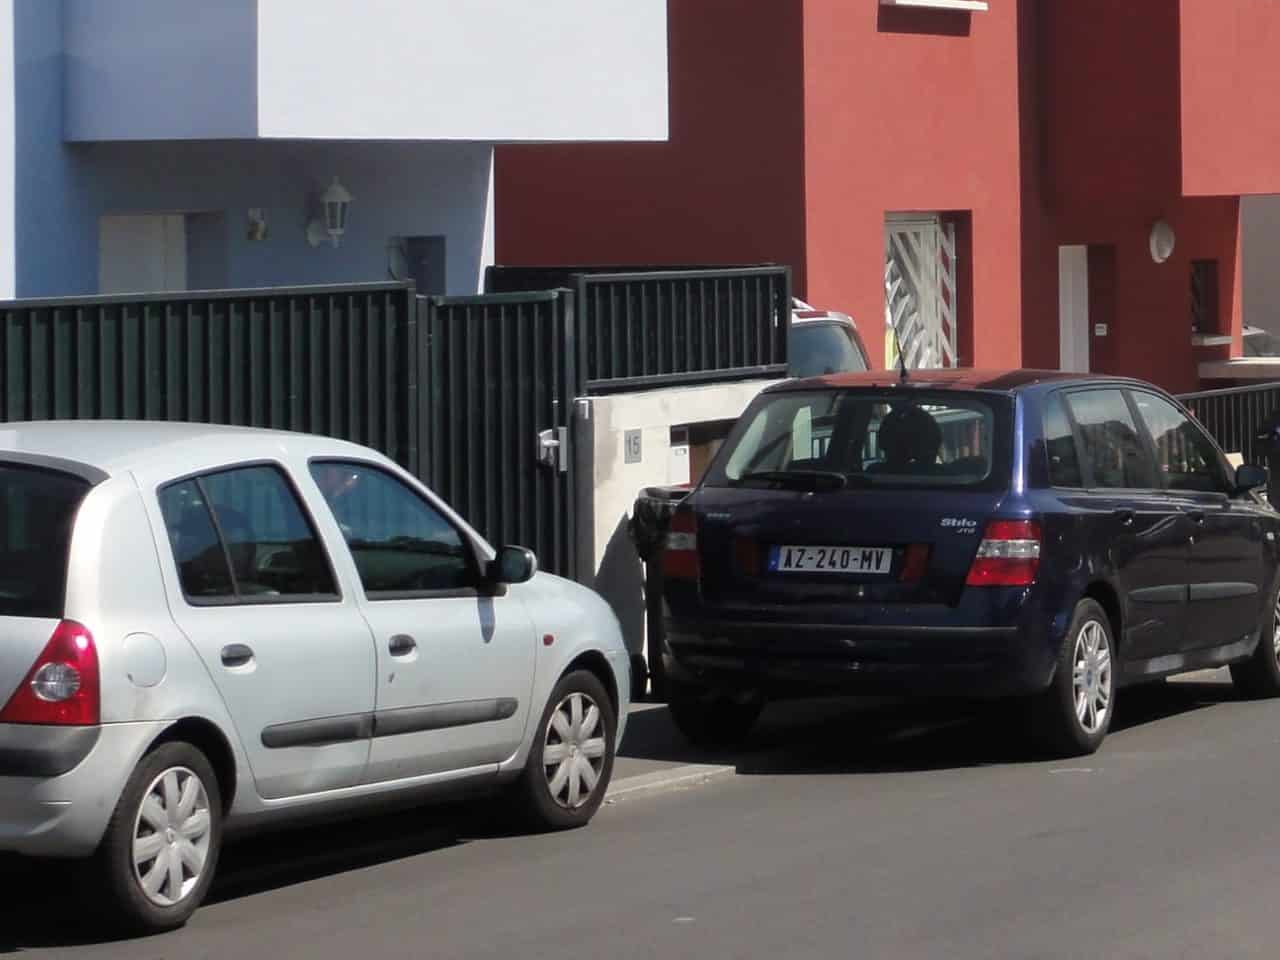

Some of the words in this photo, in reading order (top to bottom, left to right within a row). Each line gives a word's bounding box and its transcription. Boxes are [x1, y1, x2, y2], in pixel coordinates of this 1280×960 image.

[627, 435, 640, 456] 15
[940, 517, 977, 527] Stilo
[784, 548, 885, 570] AZ-240-MV
